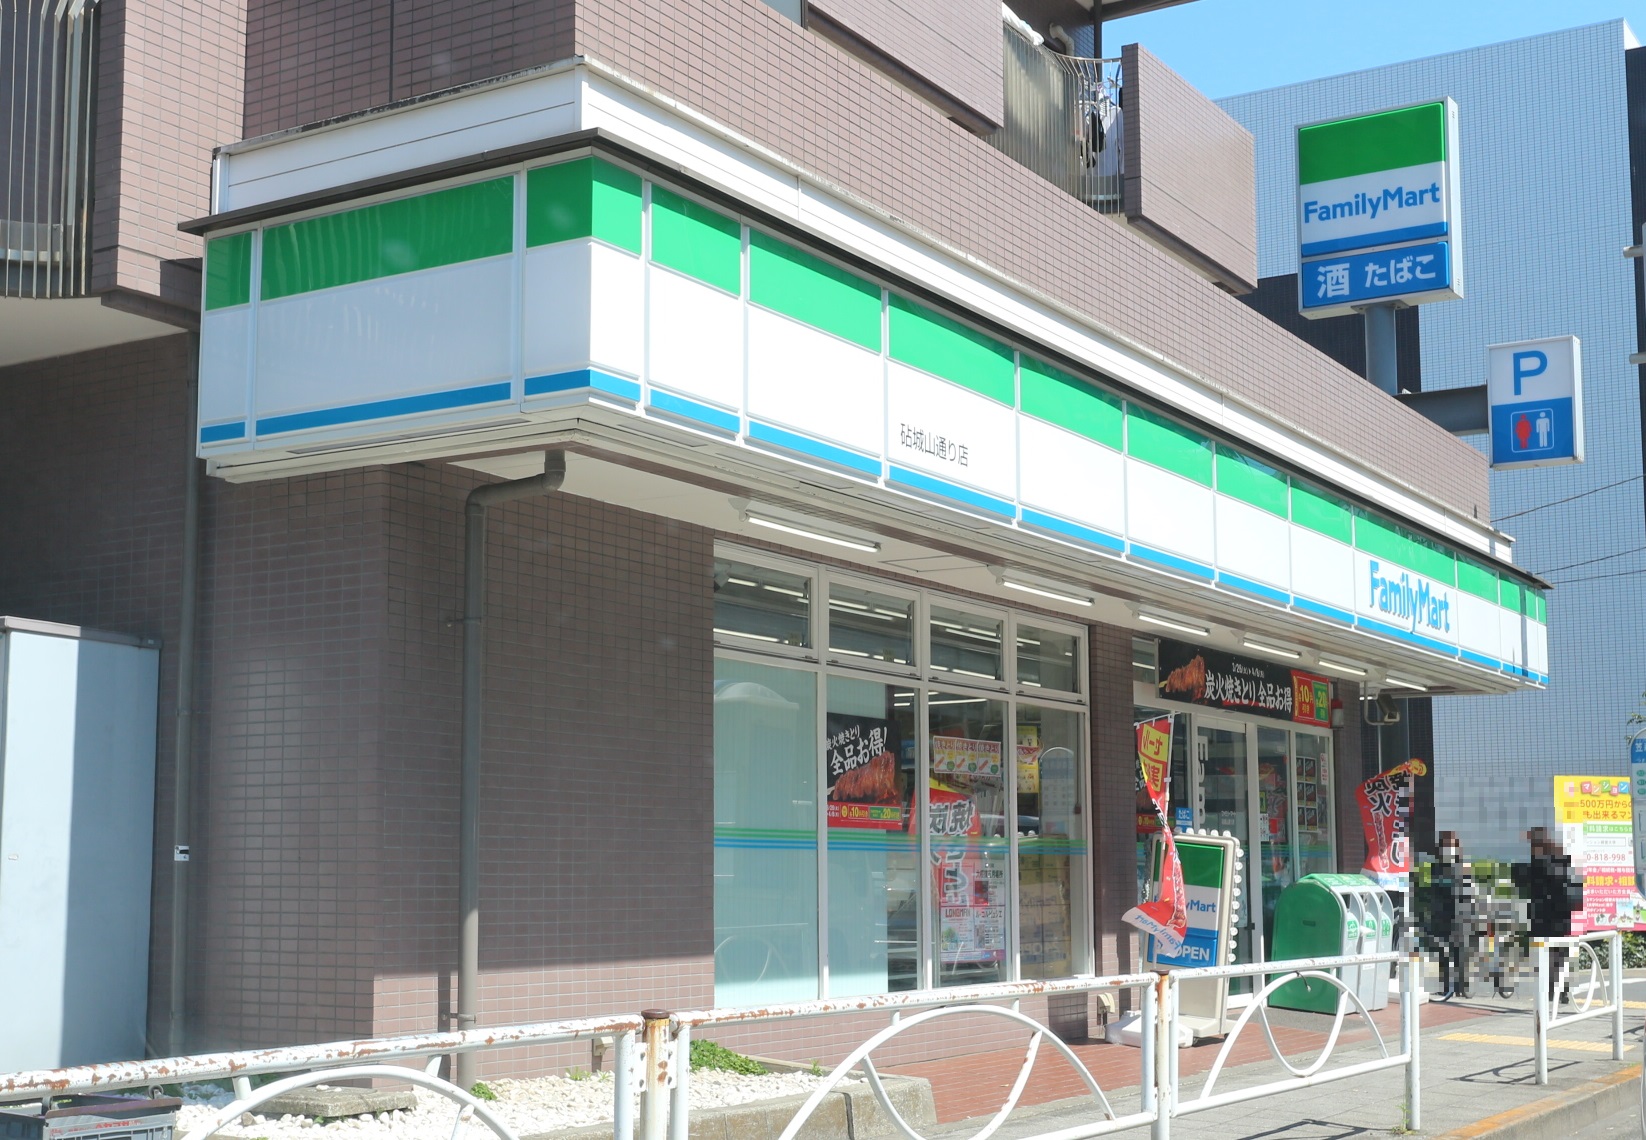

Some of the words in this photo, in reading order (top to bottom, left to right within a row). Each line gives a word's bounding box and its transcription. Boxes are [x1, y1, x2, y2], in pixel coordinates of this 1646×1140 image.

[1304, 182, 1440, 224] FamilyMart
[1317, 264, 1350, 299] 酒
[1365, 255, 1436, 289] たばこ
[1512, 350, 1547, 396] P
[900, 422, 969, 467] 砧城山通り店
[1369, 559, 1450, 635] FamilyMart
[1204, 669, 1256, 707] 炭火焼きとり
[1258, 680, 1293, 714] 全品お得
[1583, 781, 1627, 793] マンション
